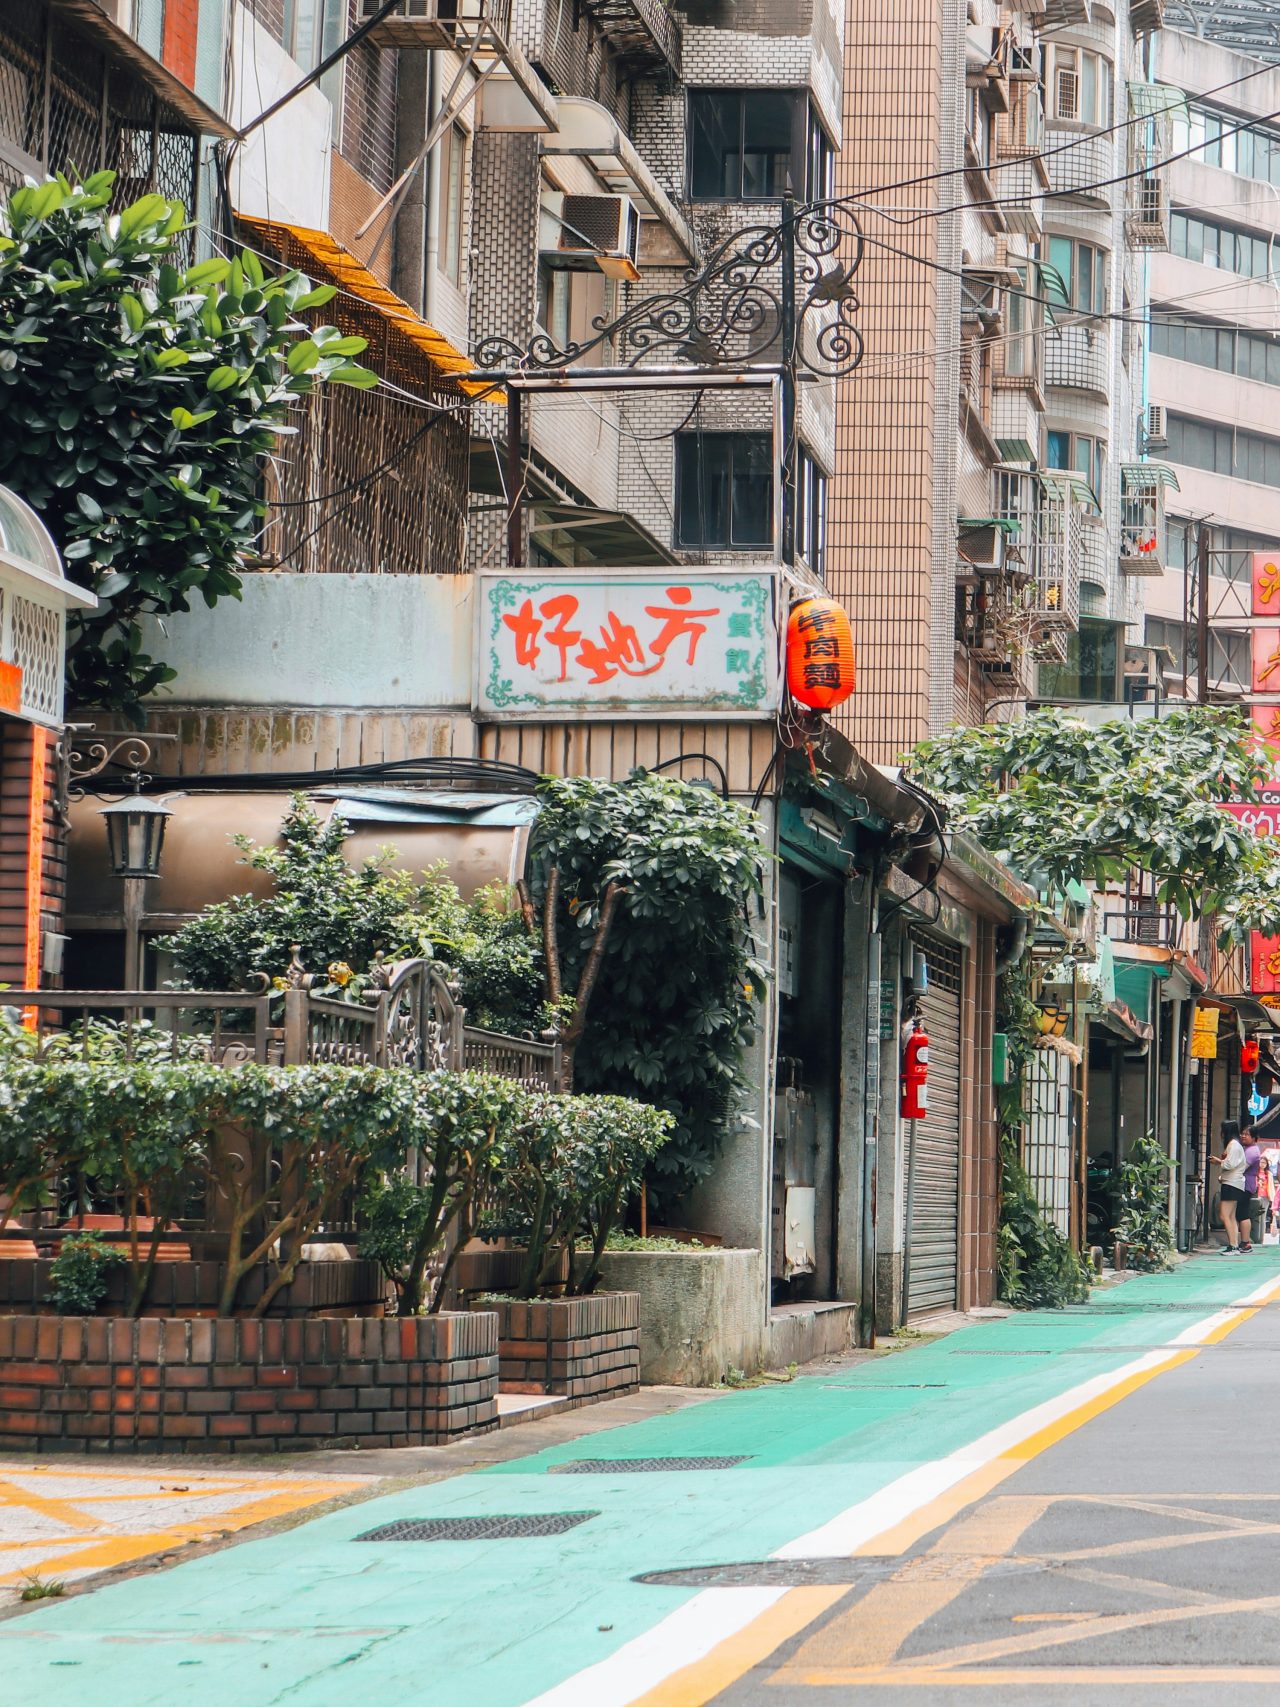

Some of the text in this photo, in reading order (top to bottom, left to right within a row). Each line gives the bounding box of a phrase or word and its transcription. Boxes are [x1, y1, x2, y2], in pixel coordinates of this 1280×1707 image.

[501, 586, 721, 684] 好地方
[725, 612, 752, 673] 餐飲
[797, 608, 842, 690] 牛肉麵
